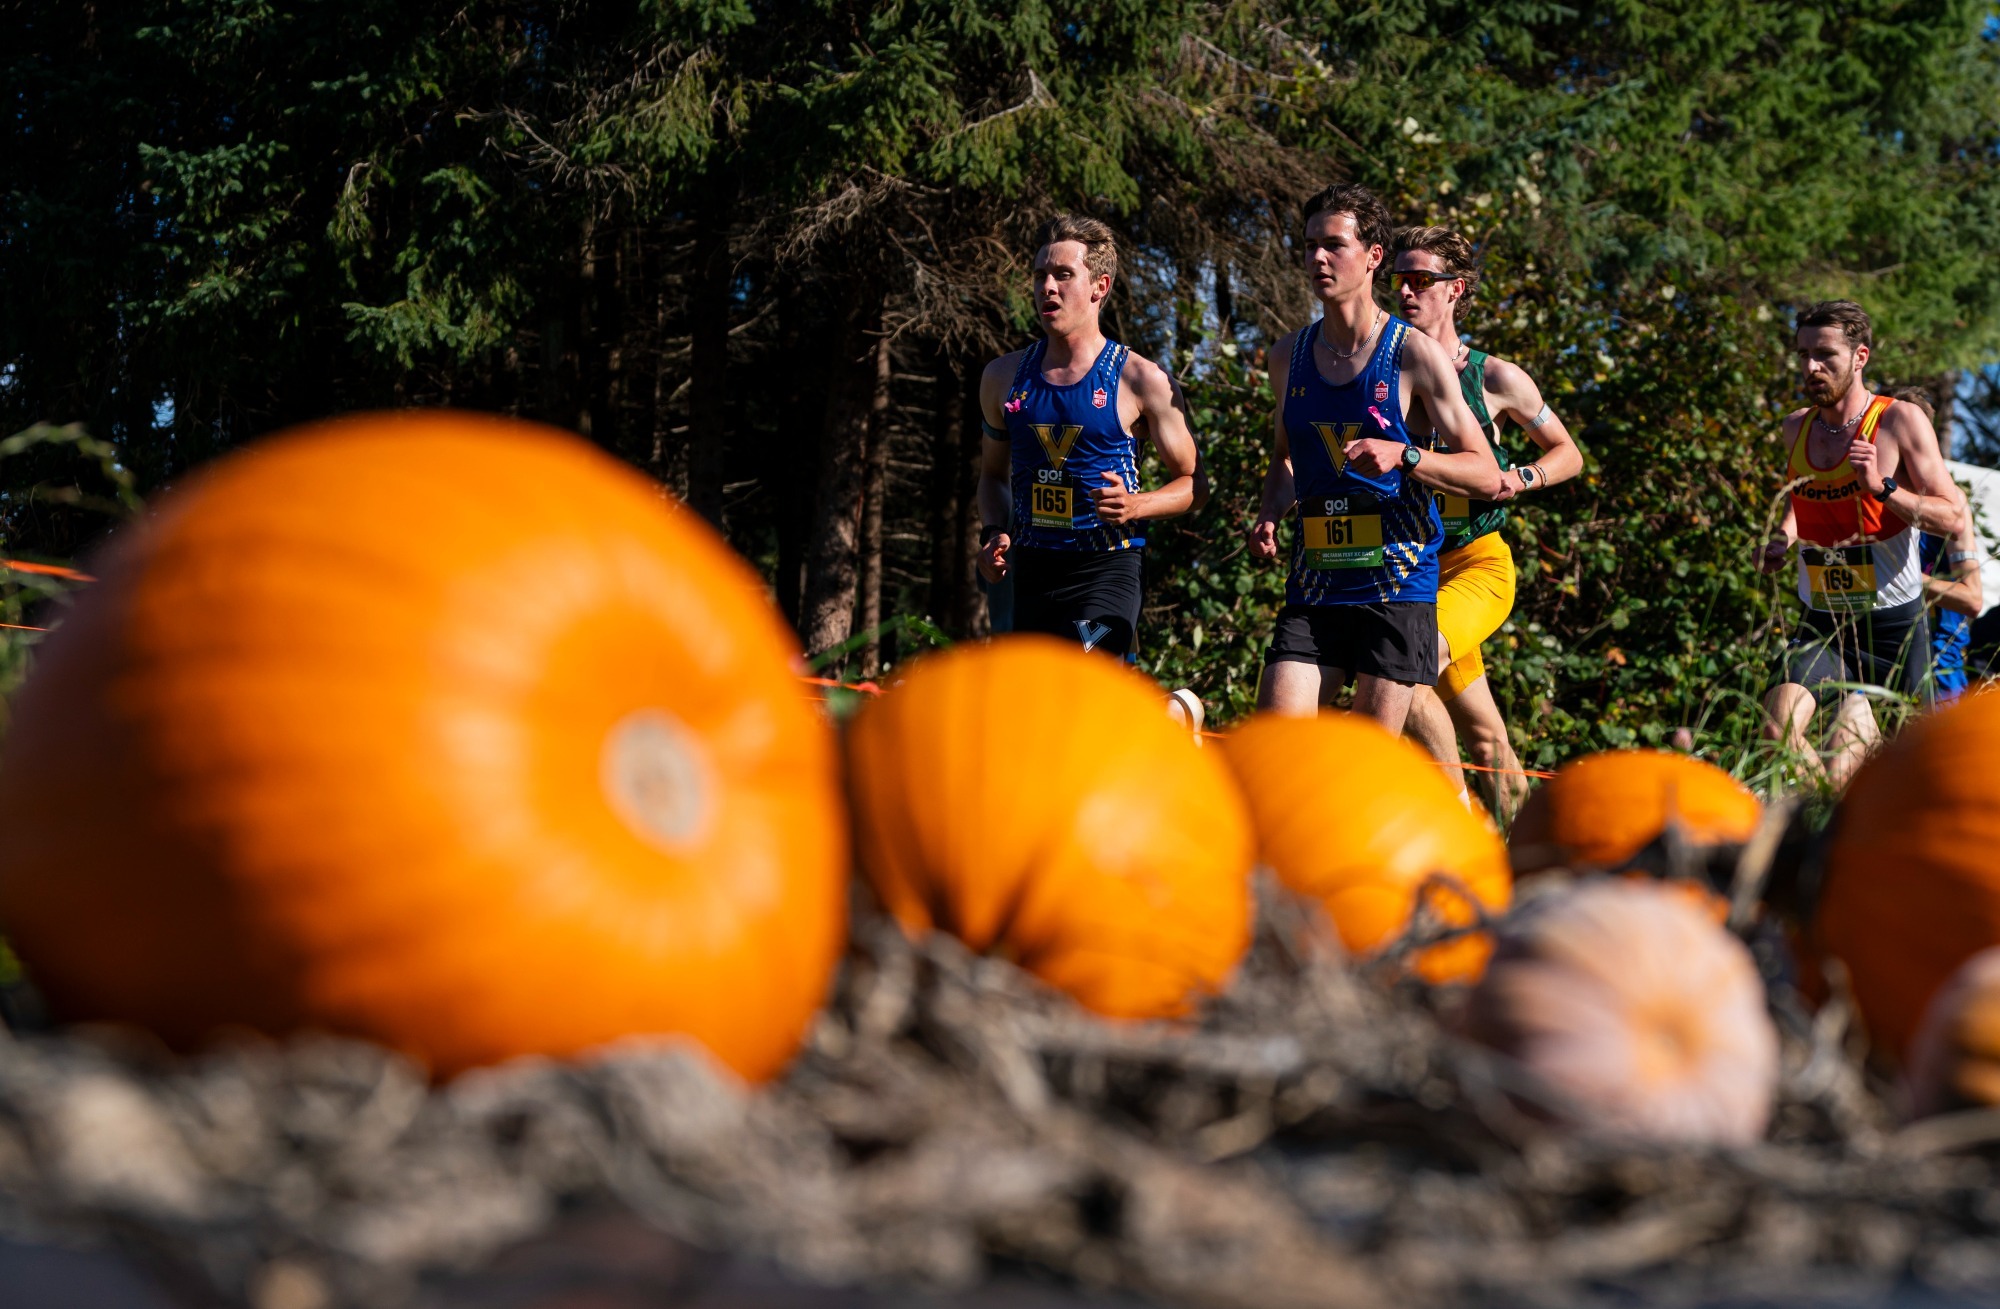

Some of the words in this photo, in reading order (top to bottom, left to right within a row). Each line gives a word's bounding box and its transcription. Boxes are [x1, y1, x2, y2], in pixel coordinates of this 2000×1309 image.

[1027, 423, 1084, 471] V
[1309, 421, 1363, 478] V
[1037, 469, 1063, 484] go!
[1033, 486, 1067, 514] 165
[1324, 497, 1349, 516] go!
[1324, 518, 1353, 545] 161
[1823, 568, 1854, 590] 169
[1072, 619, 1112, 654] V
